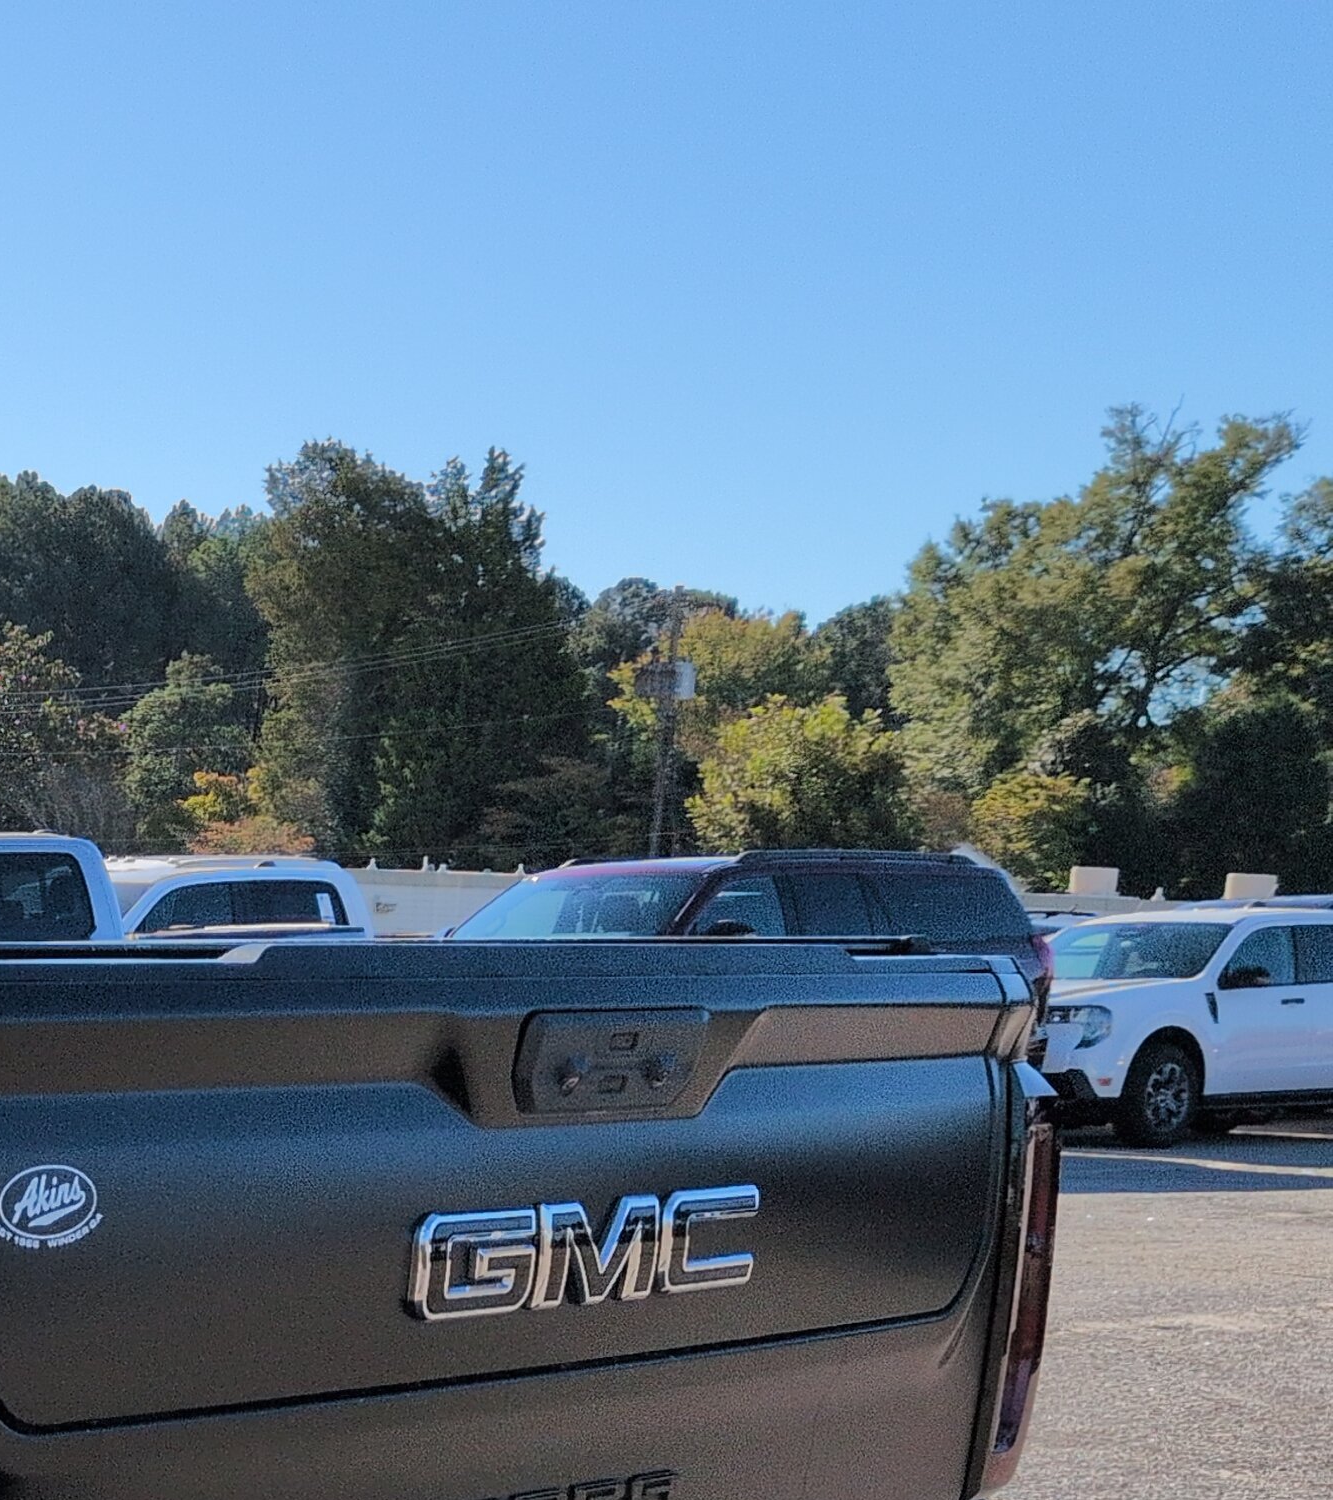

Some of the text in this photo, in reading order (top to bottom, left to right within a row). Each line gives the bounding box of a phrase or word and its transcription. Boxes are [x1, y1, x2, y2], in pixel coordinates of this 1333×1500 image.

[11, 1174, 86, 1226] Akins
[46, 1226, 90, 1248] WINDER
[407, 1184, 760, 1320] GMC
